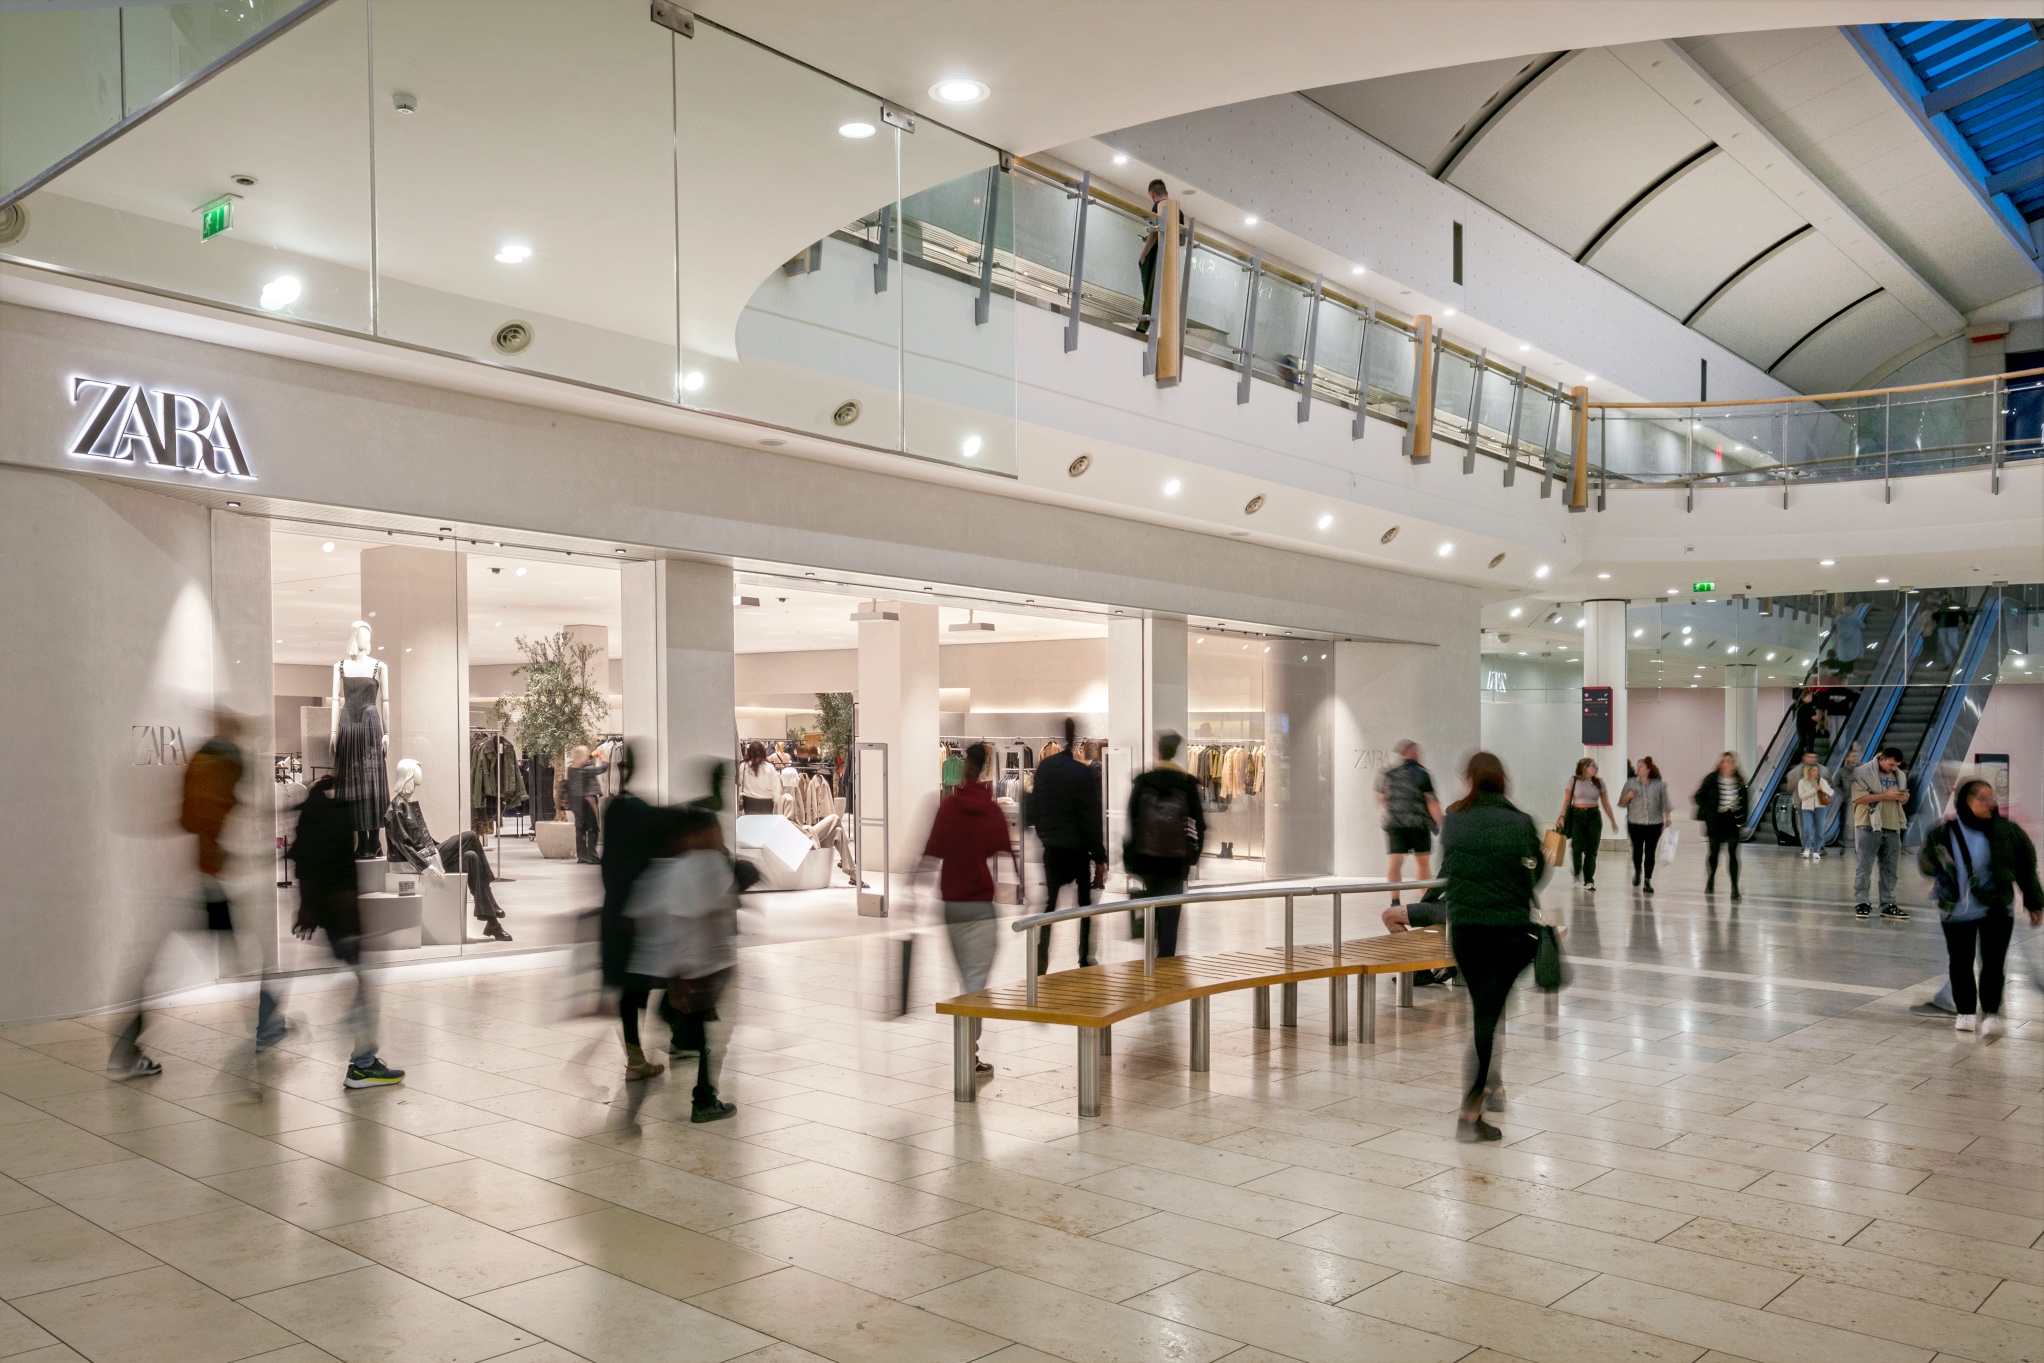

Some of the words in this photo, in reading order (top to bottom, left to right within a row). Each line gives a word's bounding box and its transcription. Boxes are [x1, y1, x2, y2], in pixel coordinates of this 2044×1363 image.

[72, 377, 259, 479] ZARA
[132, 725, 189, 766] ZARA
[1354, 749, 1392, 770] ZARA
